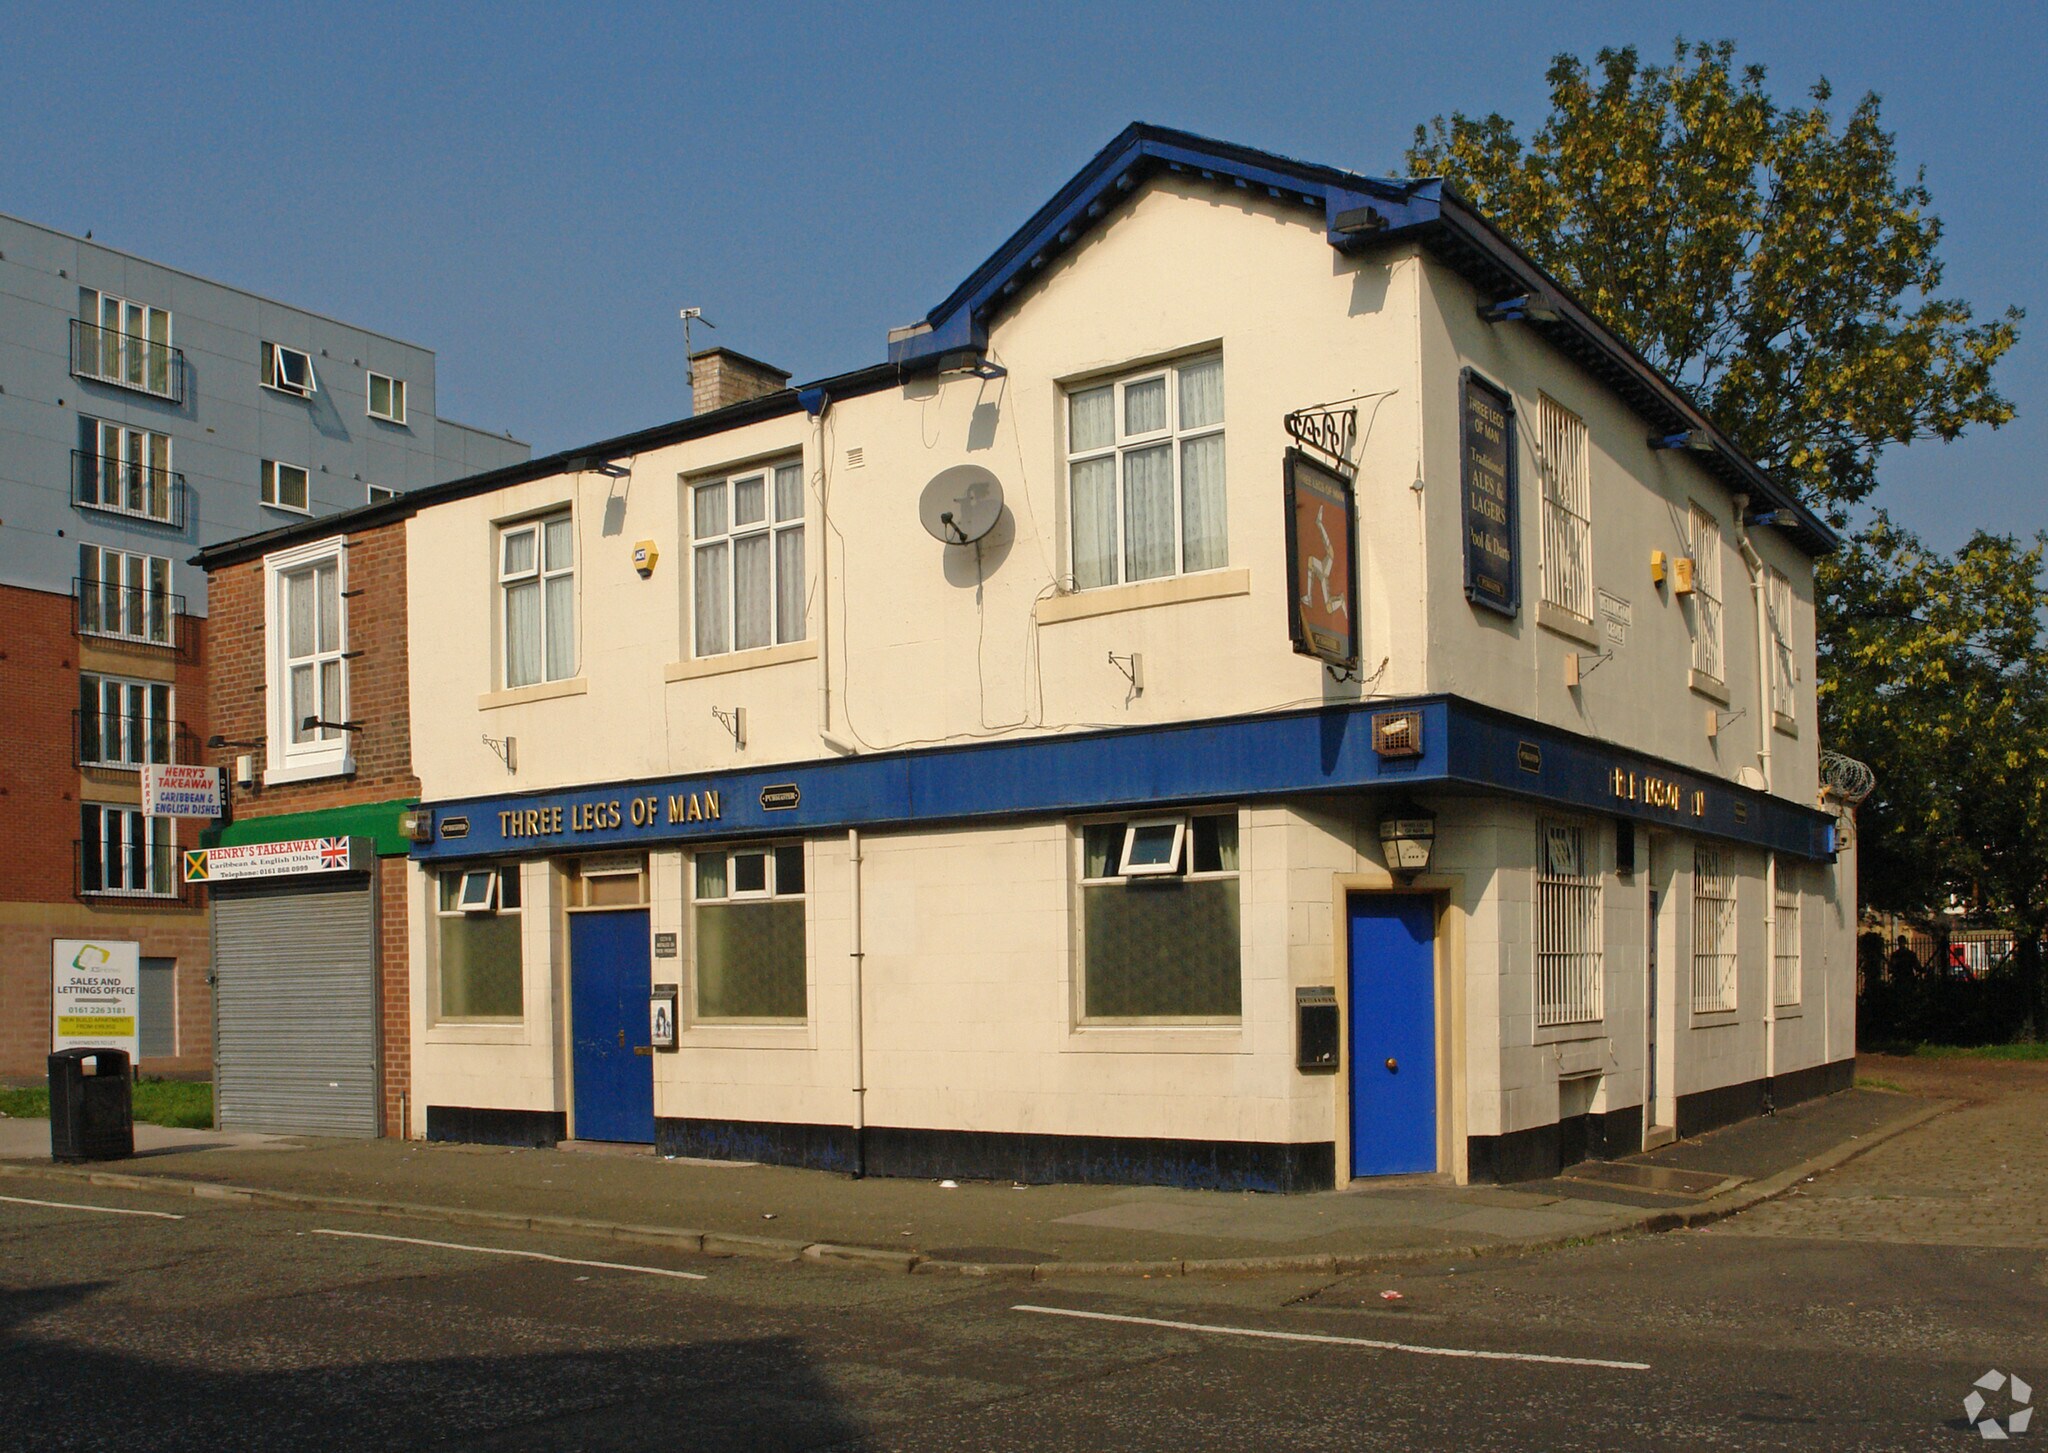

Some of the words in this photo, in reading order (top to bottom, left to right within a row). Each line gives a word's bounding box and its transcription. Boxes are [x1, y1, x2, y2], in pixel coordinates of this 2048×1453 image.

[1469, 396, 1489, 419] THREE
[1475, 419, 1483, 434] OF
[1484, 424, 1499, 445] MAN
[1472, 469, 1494, 496] ALES
[1496, 482, 1504, 501] &
[1471, 491, 1506, 525] LAGERS
[1485, 534, 1493, 553] &
[165, 767, 206, 778] HENRY'S
[158, 777, 214, 790] TAKEAWAY
[160, 792, 206, 803] CARIBBEAN
[155, 803, 190, 814] ENGLISH
[192, 804, 220, 815] DISHES
[498, 806, 562, 838] THREE
[571, 801, 622, 831] LEGS
[630, 797, 657, 826] OF
[668, 790, 720, 823] MAN
[209, 846, 255, 860] HENRY'S
[256, 839, 319, 856] TAKEAWAY
[209, 861, 248, 870] Caribbean
[260, 856, 290, 866] English
[292, 854, 320, 862] Dishes
[220, 870, 259, 878] Telephone:
[260, 867, 276, 875] 0161
[70, 977, 98, 986] SALES
[100, 978, 121, 986] AND
[57, 986, 102, 995] LETTINGS
[103, 986, 135, 995] OFFICE
[68, 1006, 88, 1014] 0161
[90, 1006, 105, 1014] 226
[106, 1006, 126, 1014] 3181
